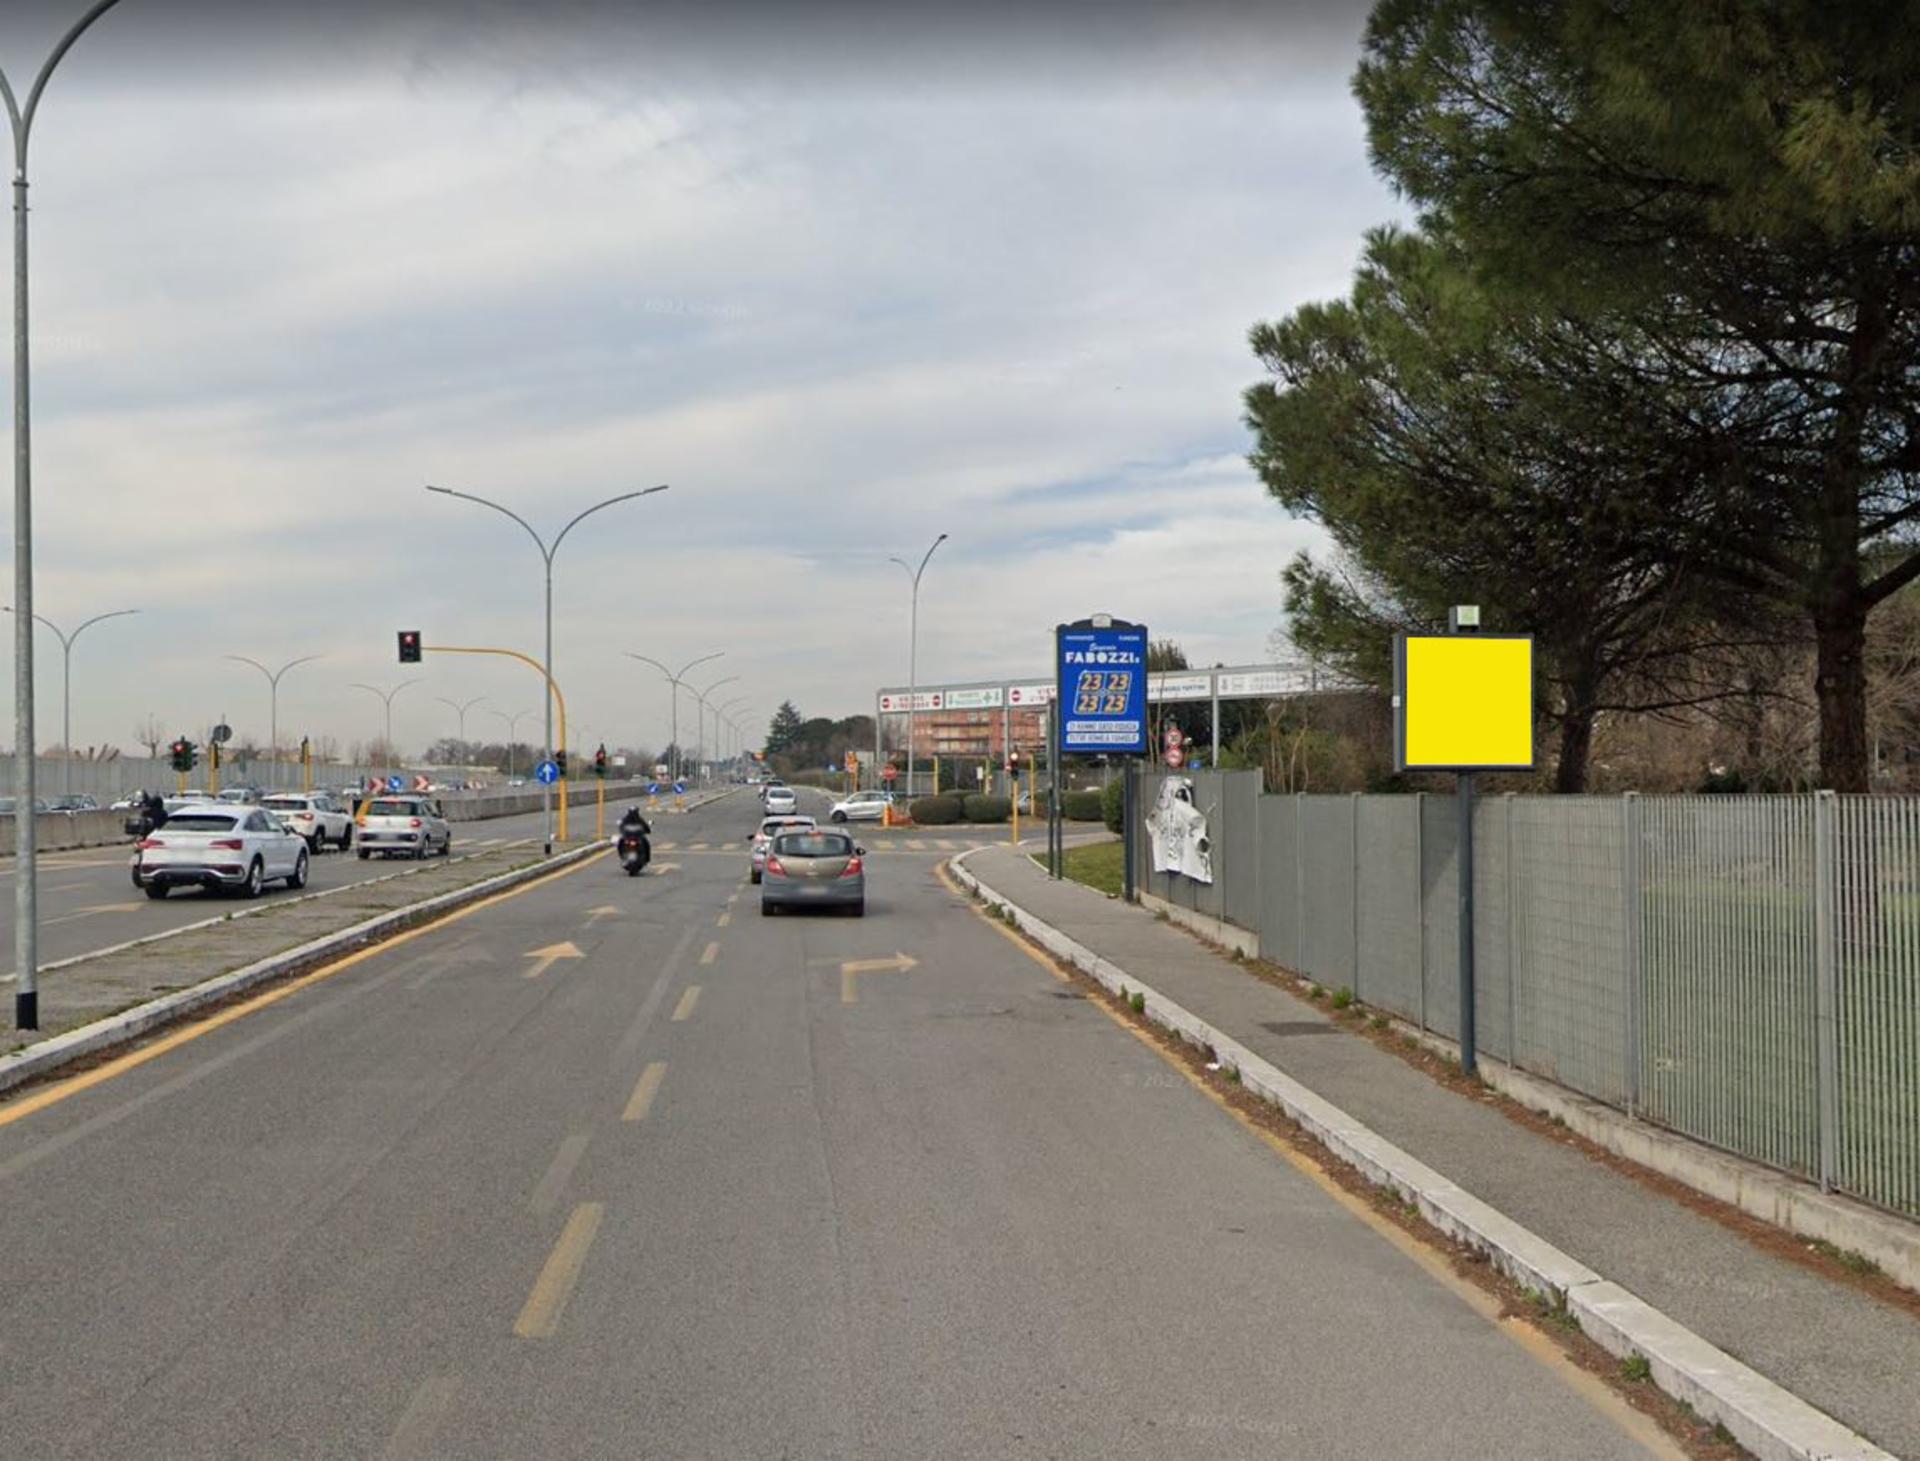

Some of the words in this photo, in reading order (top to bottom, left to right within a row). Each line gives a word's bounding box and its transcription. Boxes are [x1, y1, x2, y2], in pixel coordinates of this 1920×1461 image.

[1081, 673, 1102, 690] 23
[1108, 673, 1129, 690] 23
[1078, 695, 1099, 712] 23
[1104, 695, 1125, 713] 23
